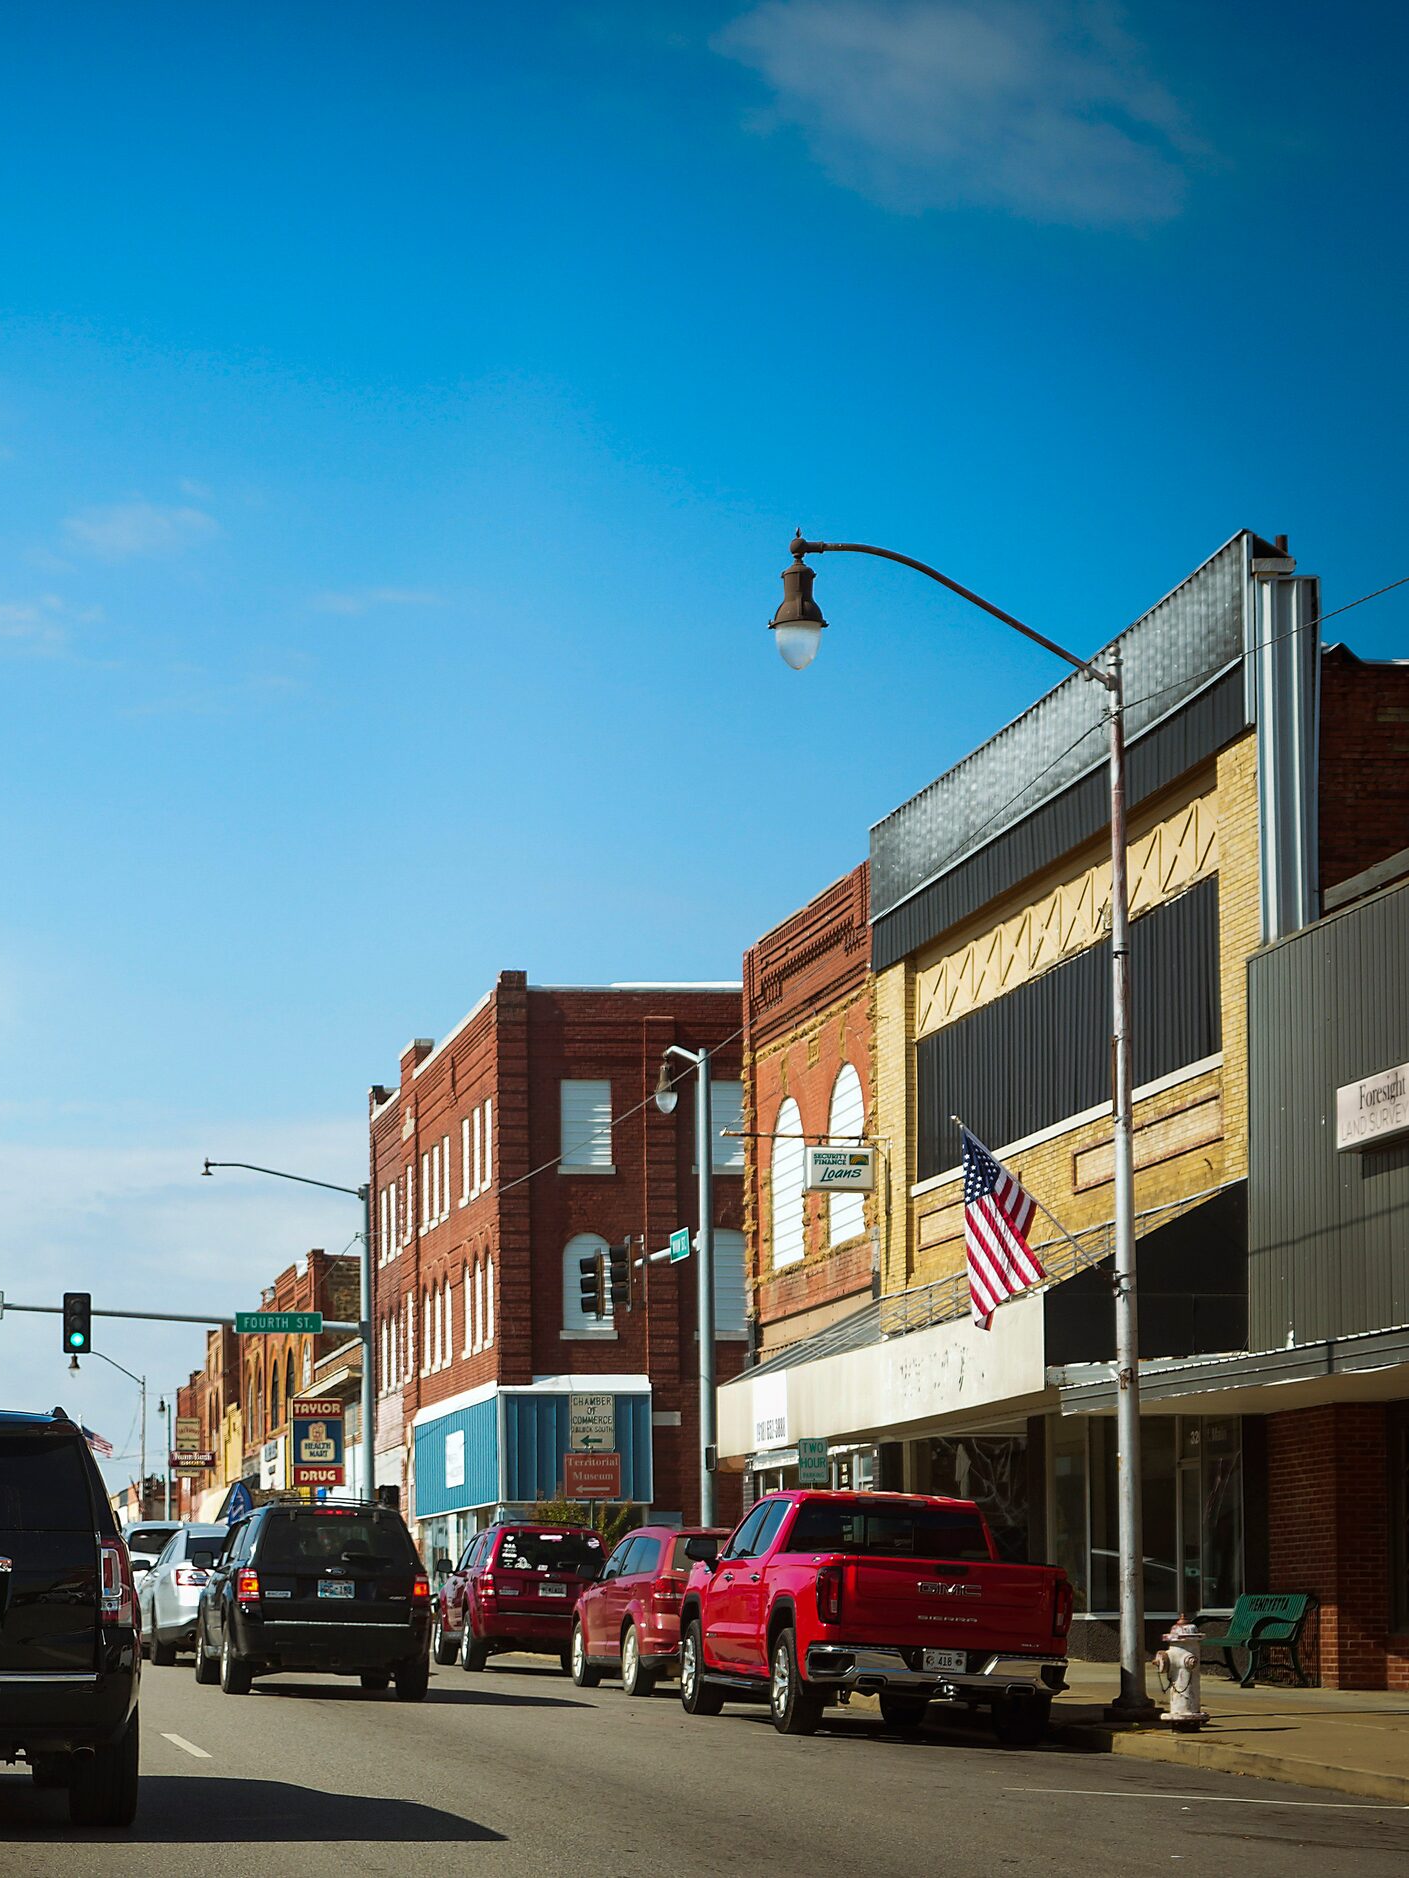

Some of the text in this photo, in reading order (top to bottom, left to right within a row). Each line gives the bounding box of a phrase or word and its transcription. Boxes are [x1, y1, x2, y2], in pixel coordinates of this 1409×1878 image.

[1359, 1072, 1406, 1110] Foresight
[1342, 1116, 1368, 1141] LAND
[820, 1167, 862, 1182] Loans
[244, 1317, 313, 1328] FOURTH ST.
[573, 1397, 612, 1405] CHAMBER
[294, 1403, 341, 1414] TAYLOR
[586, 1407, 597, 1415] OF
[572, 1416, 612, 1424] COMMERCE
[304, 1442, 331, 1450] HEALTH
[803, 1442, 824, 1453] TWO
[568, 1457, 619, 1466] Territorial
[800, 1457, 826, 1468] HOUR
[300, 1470, 336, 1481] DRUG
[573, 1471, 613, 1480] Museum
[917, 1582, 982, 1596] GMC
[937, 1656, 953, 1667] 418
